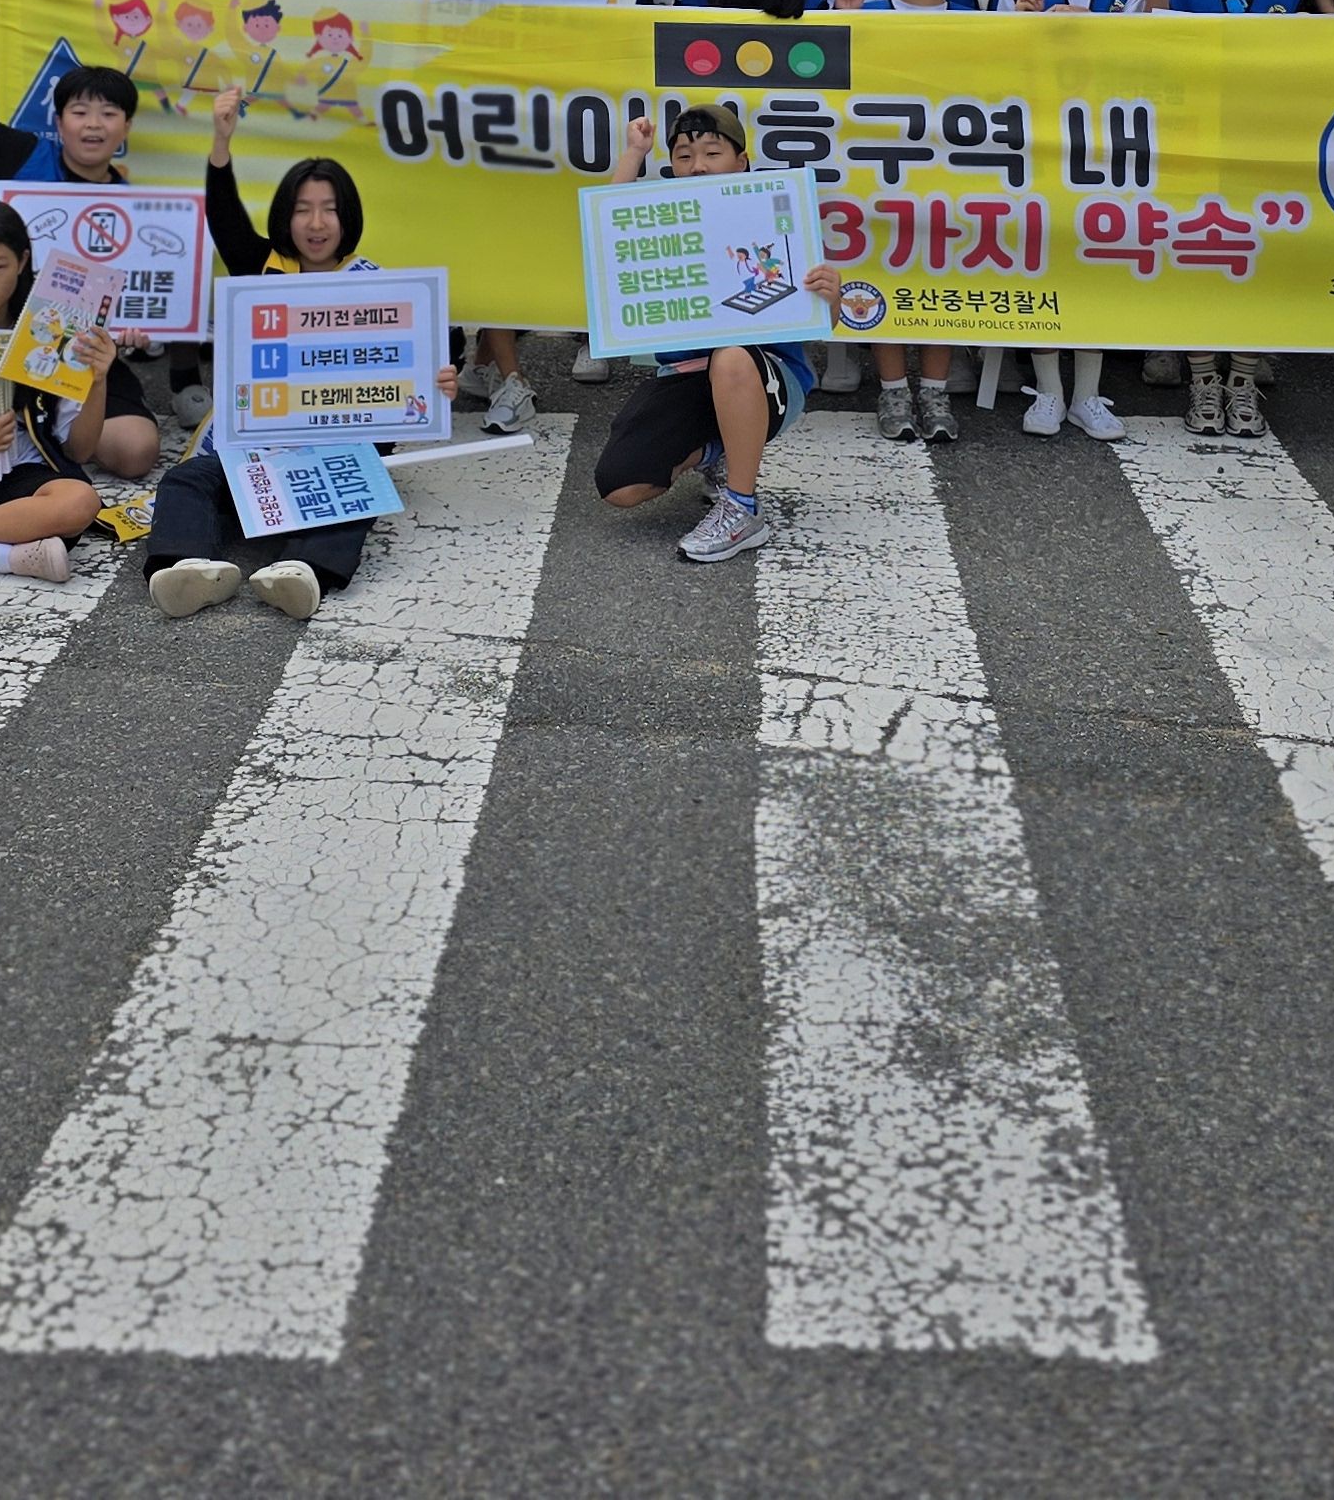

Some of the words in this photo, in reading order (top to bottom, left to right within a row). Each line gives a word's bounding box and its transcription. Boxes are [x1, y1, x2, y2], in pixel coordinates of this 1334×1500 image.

[379, 87, 1025, 188] 어린이호구역
[1067, 105, 1152, 189] 내
[721, 180, 785, 196] 내황초등학교
[611, 198, 702, 231] 무단횡단
[614, 230, 706, 263] 위험해요
[819, 200, 1044, 272] 3가지
[120, 270, 175, 294] 대폰
[618, 263, 710, 296] 횡단보도
[115, 296, 167, 320] 름길
[621, 295, 714, 328] 이용해요
[892, 288, 1060, 315] 울산중부경찰서
[259, 308, 281, 331] 가
[300, 309, 331, 328] 가기
[334, 308, 349, 326] 전
[353, 307, 399, 327] 살피고
[894, 317, 929, 327] ULSAN
[933, 318, 976, 329] JUNGBU
[979, 320, 1015, 330] POLICE
[1018, 320, 1061, 331] STATION
[259, 347, 281, 369] 나
[301, 347, 348, 367] 나부터
[353, 346, 399, 365] 멈추고
[259, 386, 281, 409] 다
[301, 389, 317, 407] 다
[320, 387, 353, 406] 함께
[356, 384, 400, 403] 천천히
[308, 412, 373, 426] 내황초등학교
[285, 465, 338, 523] 교통신호
